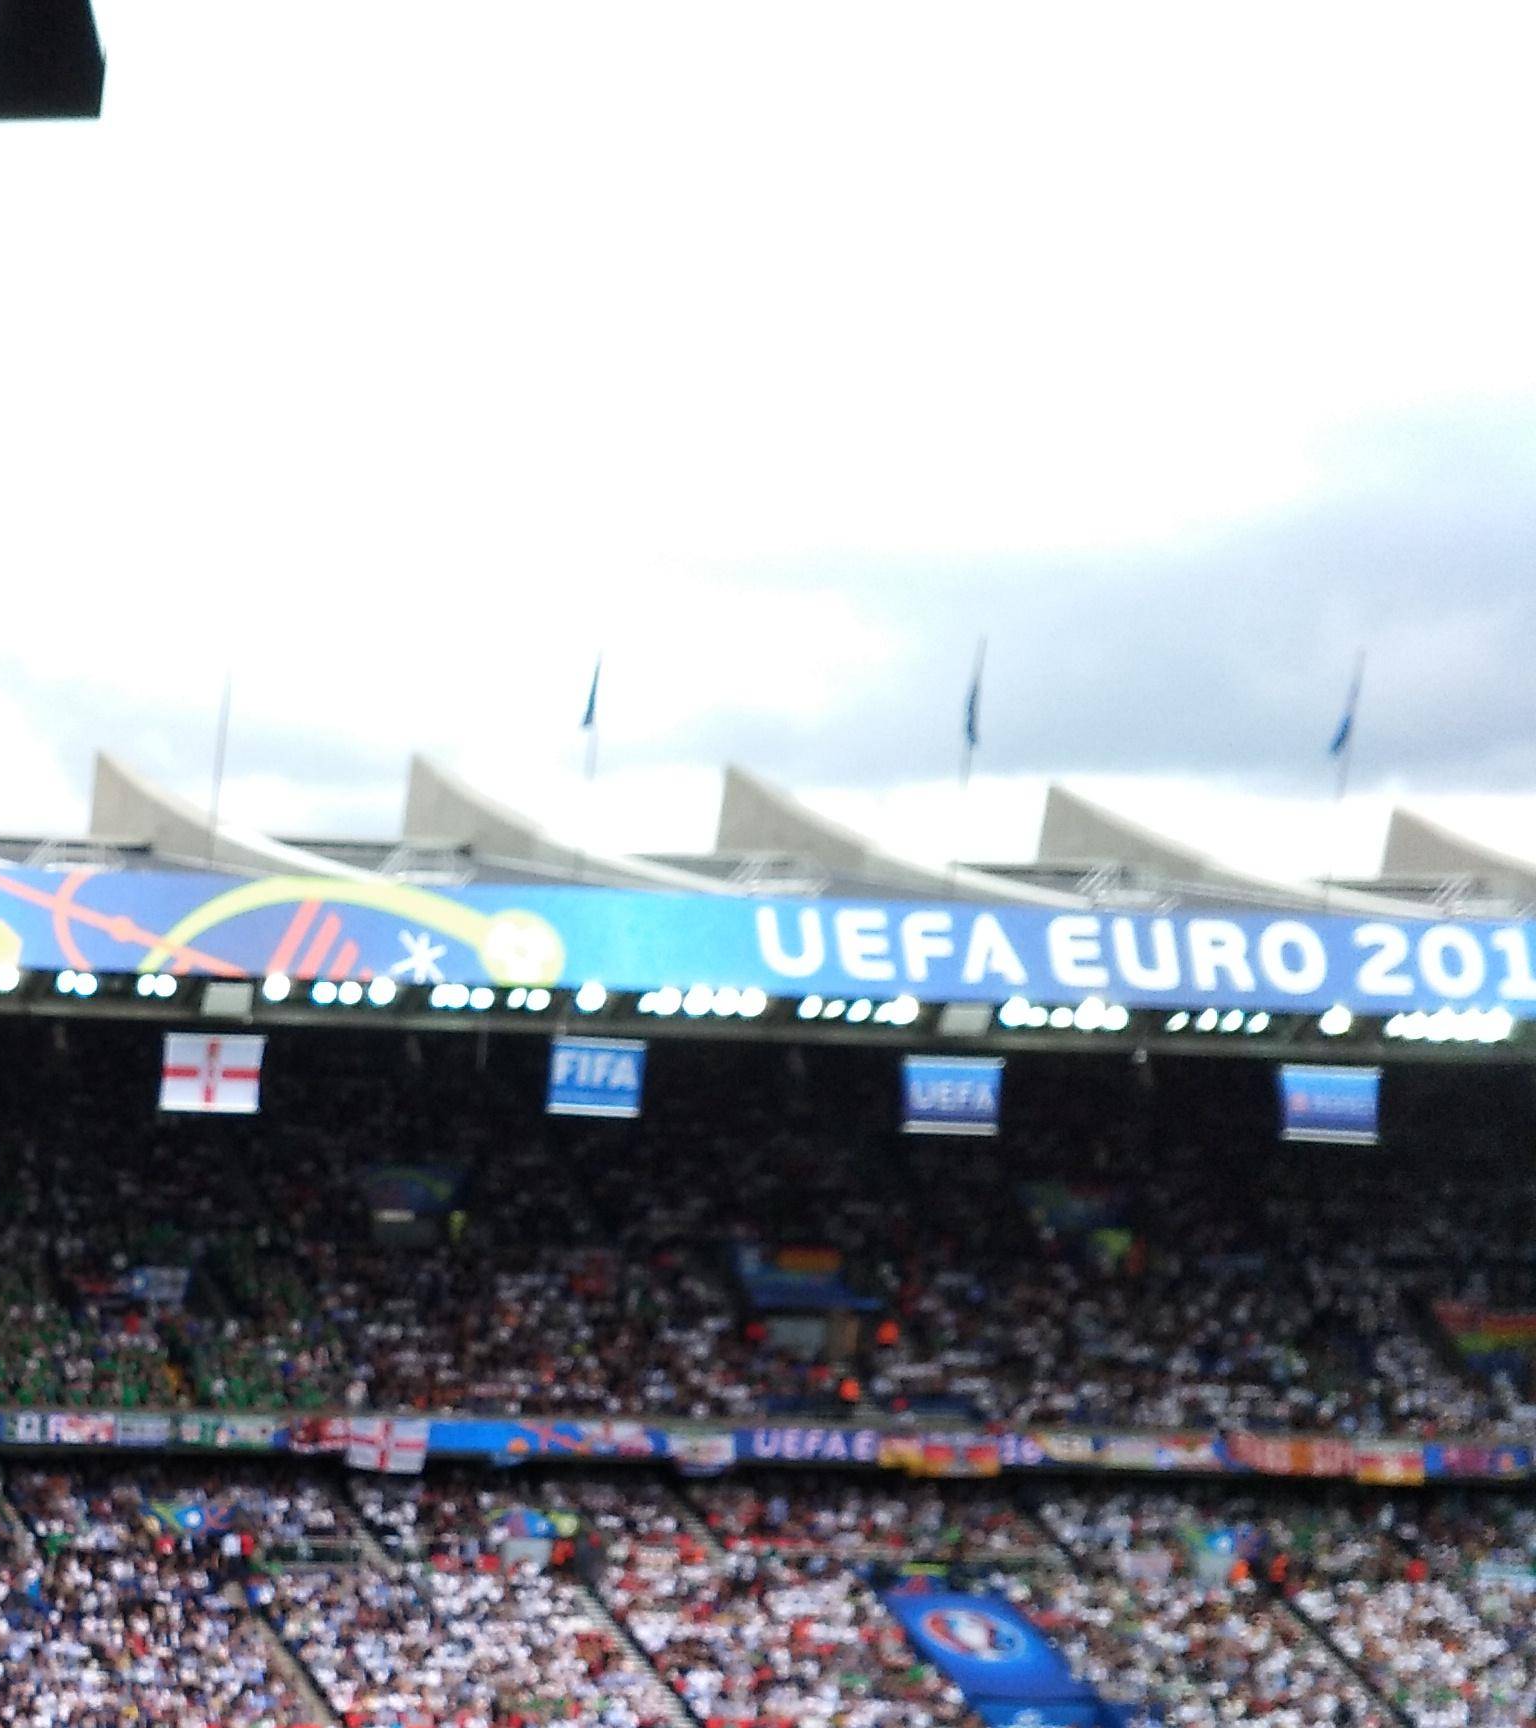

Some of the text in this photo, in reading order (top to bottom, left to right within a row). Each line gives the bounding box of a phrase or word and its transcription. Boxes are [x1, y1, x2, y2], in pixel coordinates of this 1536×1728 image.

[755, 906, 1028, 986] UEFA
[1046, 914, 1328, 996] EURO
[551, 1050, 640, 1090] FIFA
[909, 1081, 995, 1111] UEFA
[752, 1428, 848, 1462] UEFA
